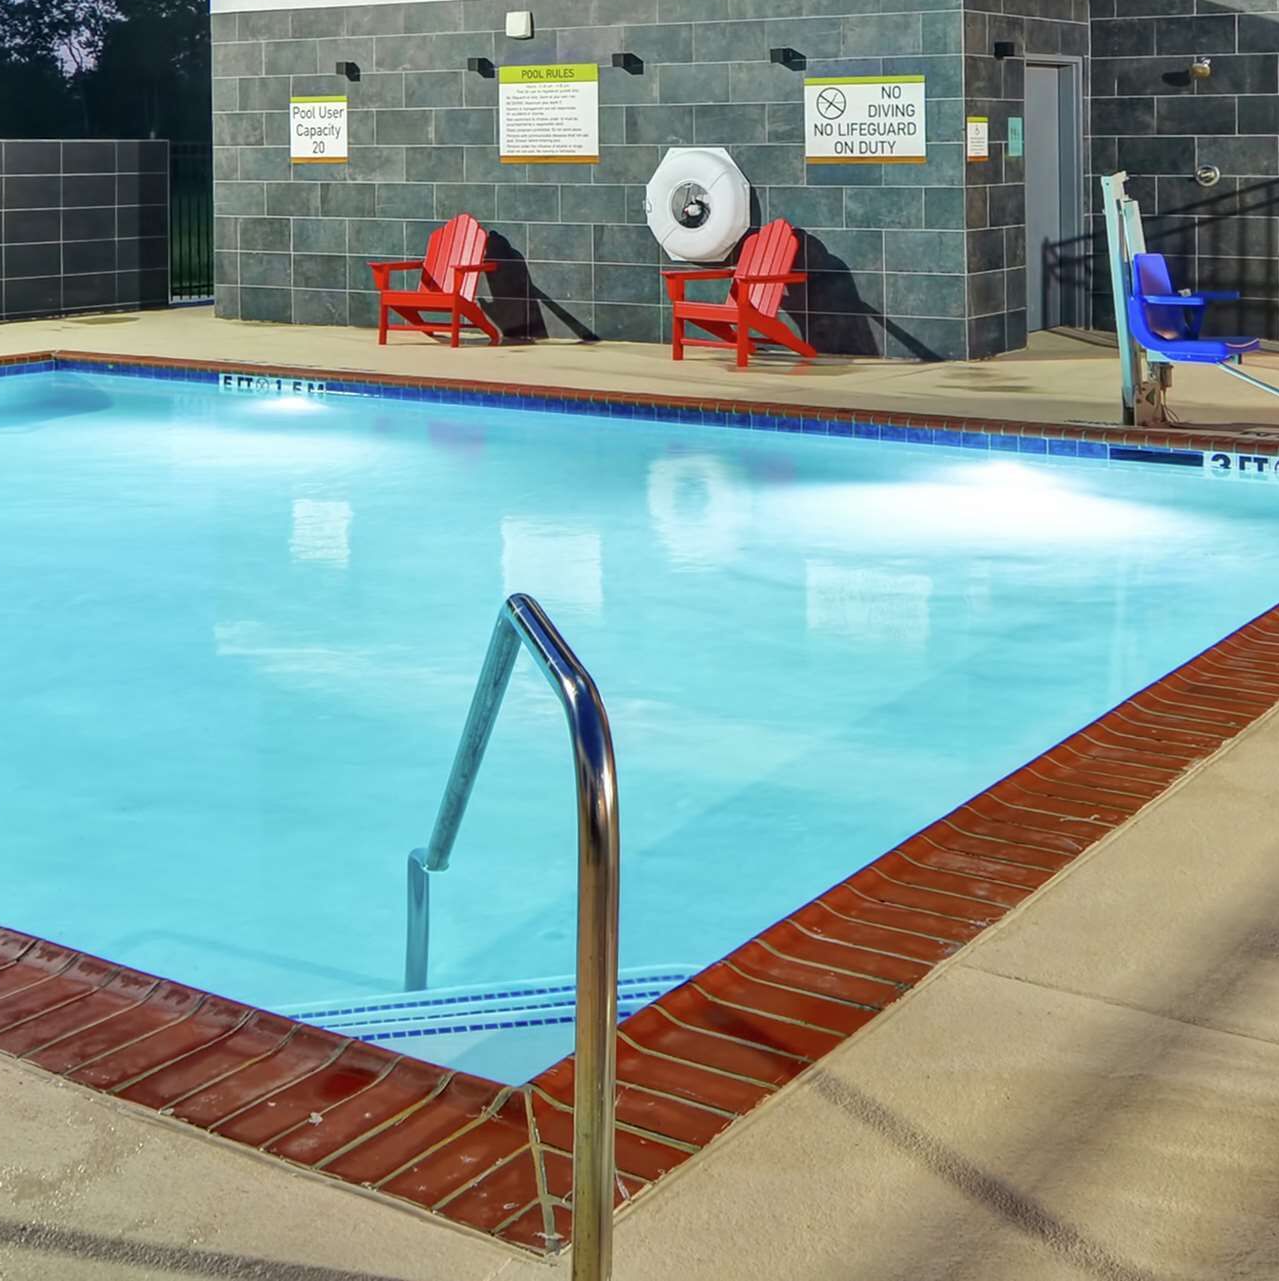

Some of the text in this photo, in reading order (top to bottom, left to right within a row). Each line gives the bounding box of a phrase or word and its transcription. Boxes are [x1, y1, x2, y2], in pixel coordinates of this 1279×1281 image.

[521, 68, 575, 79] POOL RULES
[881, 85, 902, 99] NO
[292, 106, 344, 119] Pool User
[868, 104, 916, 118] DIVING
[296, 123, 341, 140] Capacity
[814, 122, 917, 136] NO LIFEGUARD
[312, 140, 326, 154] 20
[834, 140, 897, 154] ON DUTY
